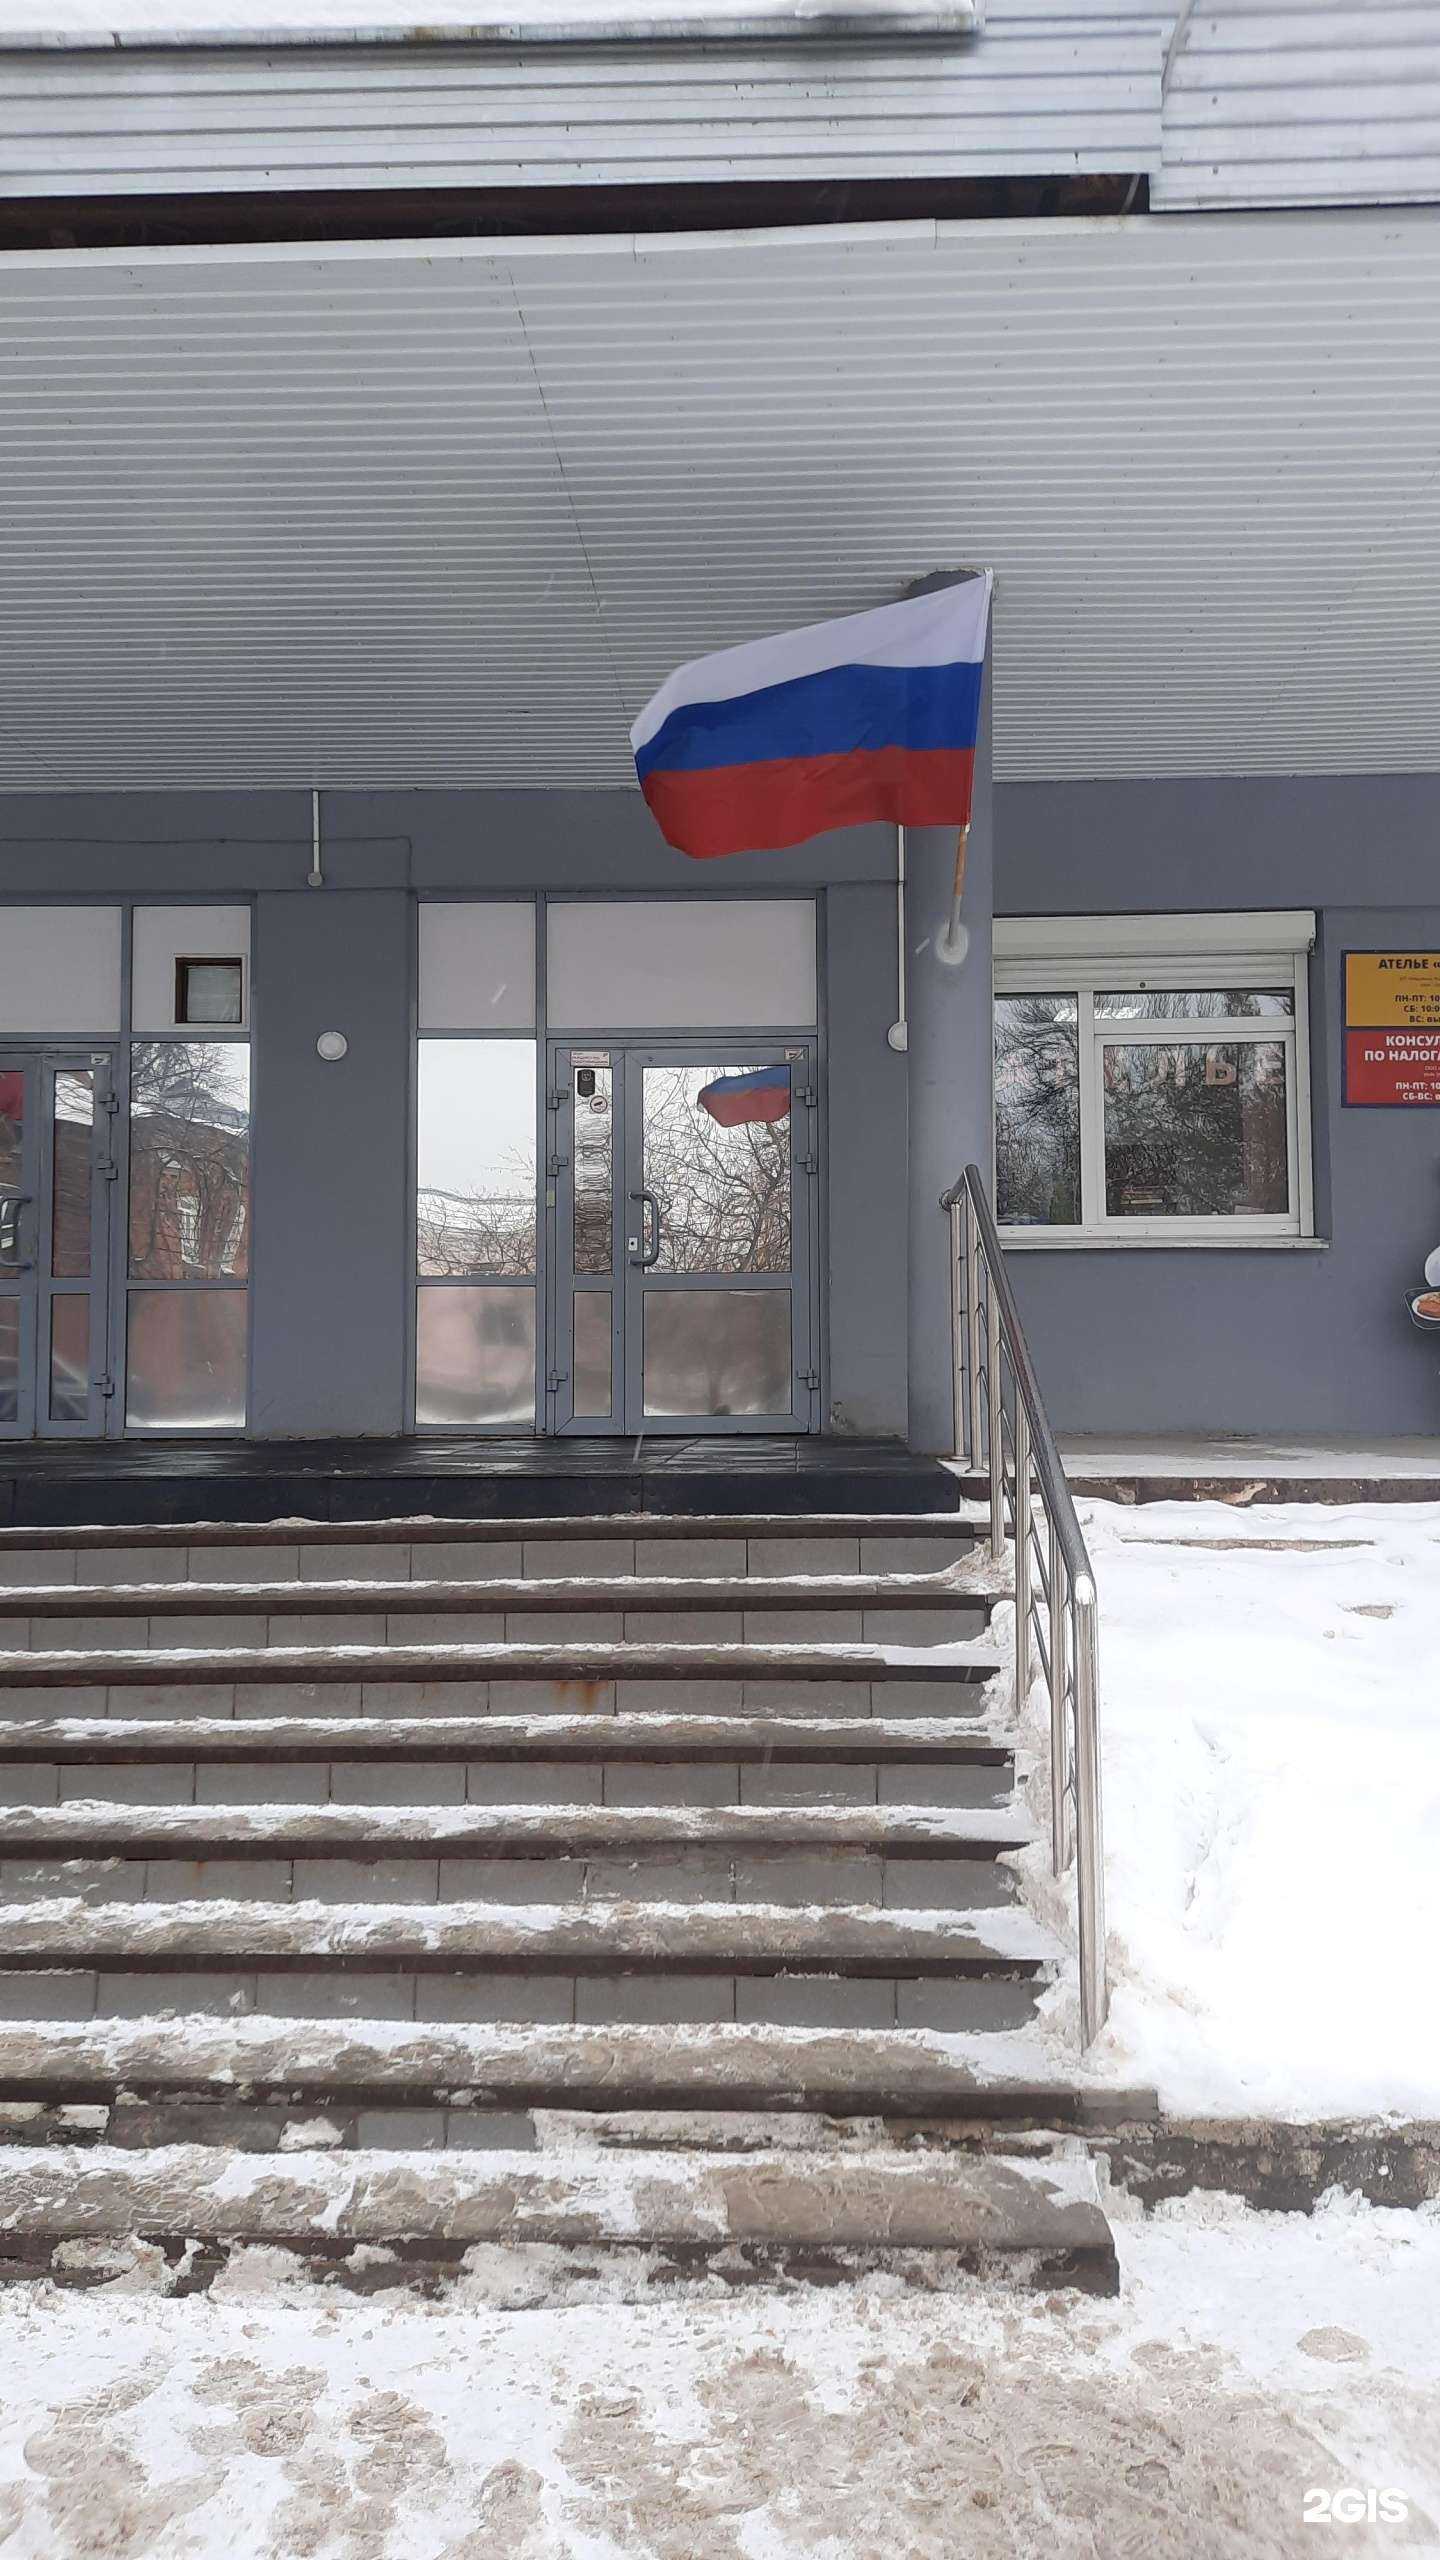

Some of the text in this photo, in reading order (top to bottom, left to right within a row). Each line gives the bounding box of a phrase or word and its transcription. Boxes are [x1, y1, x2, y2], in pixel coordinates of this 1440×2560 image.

[1378, 959, 1429, 969] АТЕЛЬЕ
[1364, 1050, 1385, 1061] ПО
[1395, 1082, 1428, 1090] ПН-ПТ:
